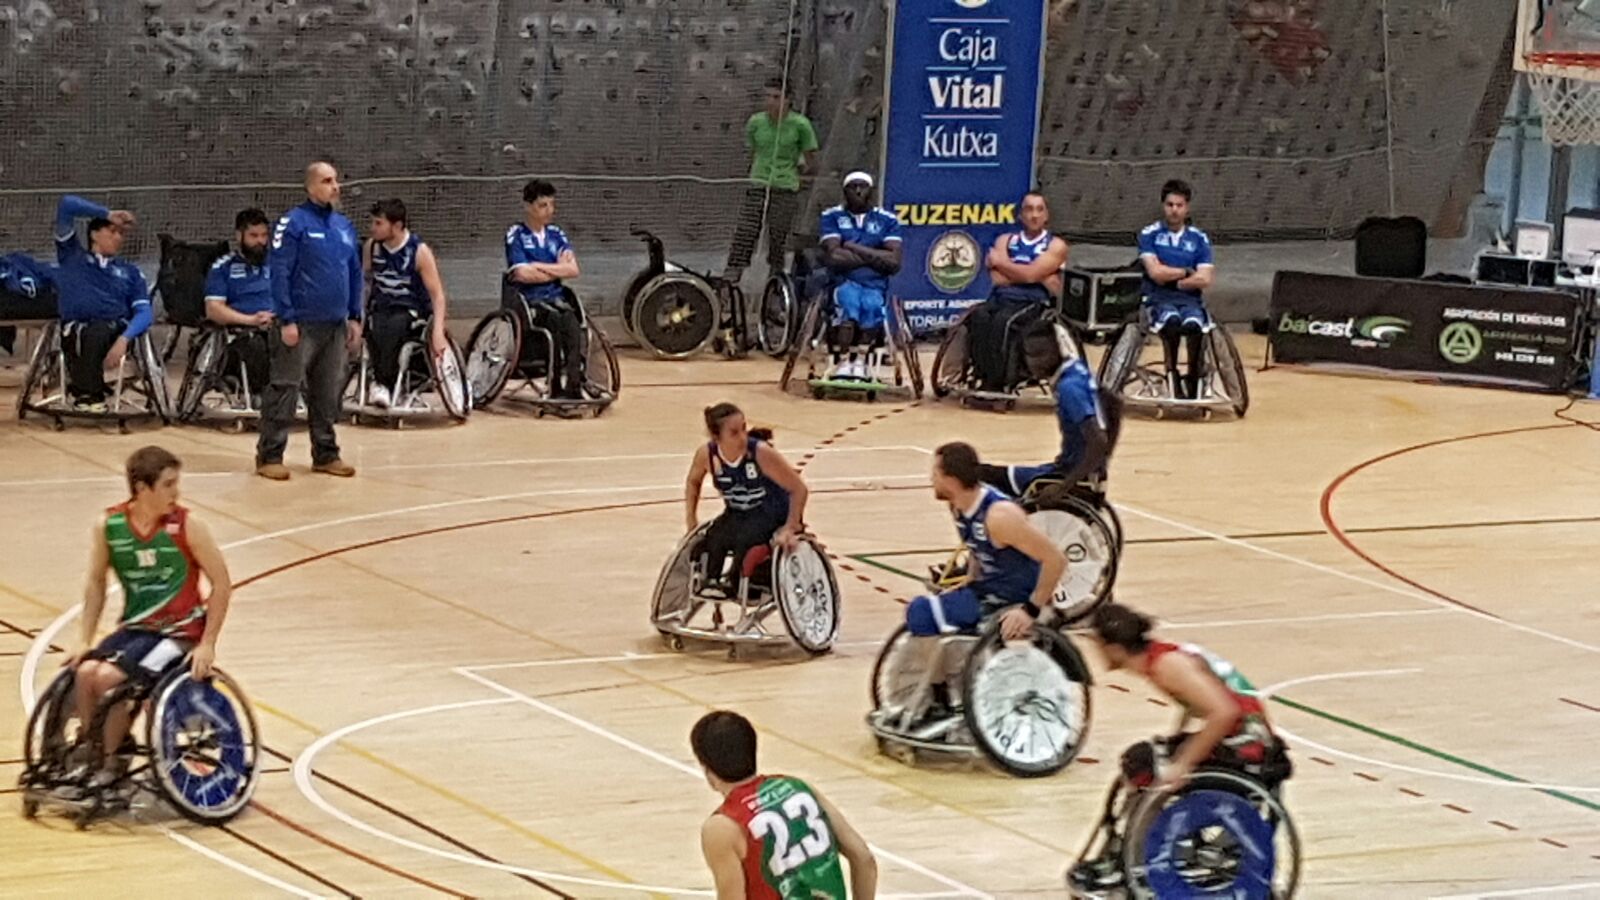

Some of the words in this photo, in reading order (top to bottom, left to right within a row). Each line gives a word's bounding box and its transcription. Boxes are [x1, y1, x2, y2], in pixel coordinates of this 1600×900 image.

[938, 28, 996, 68] Caja
[928, 75, 1003, 109] Vital
[923, 125, 998, 157] Kutxa
[895, 203, 1016, 225] ZUZENAK
[904, 300, 946, 310] EPORTE
[747, 792, 831, 877] 23
